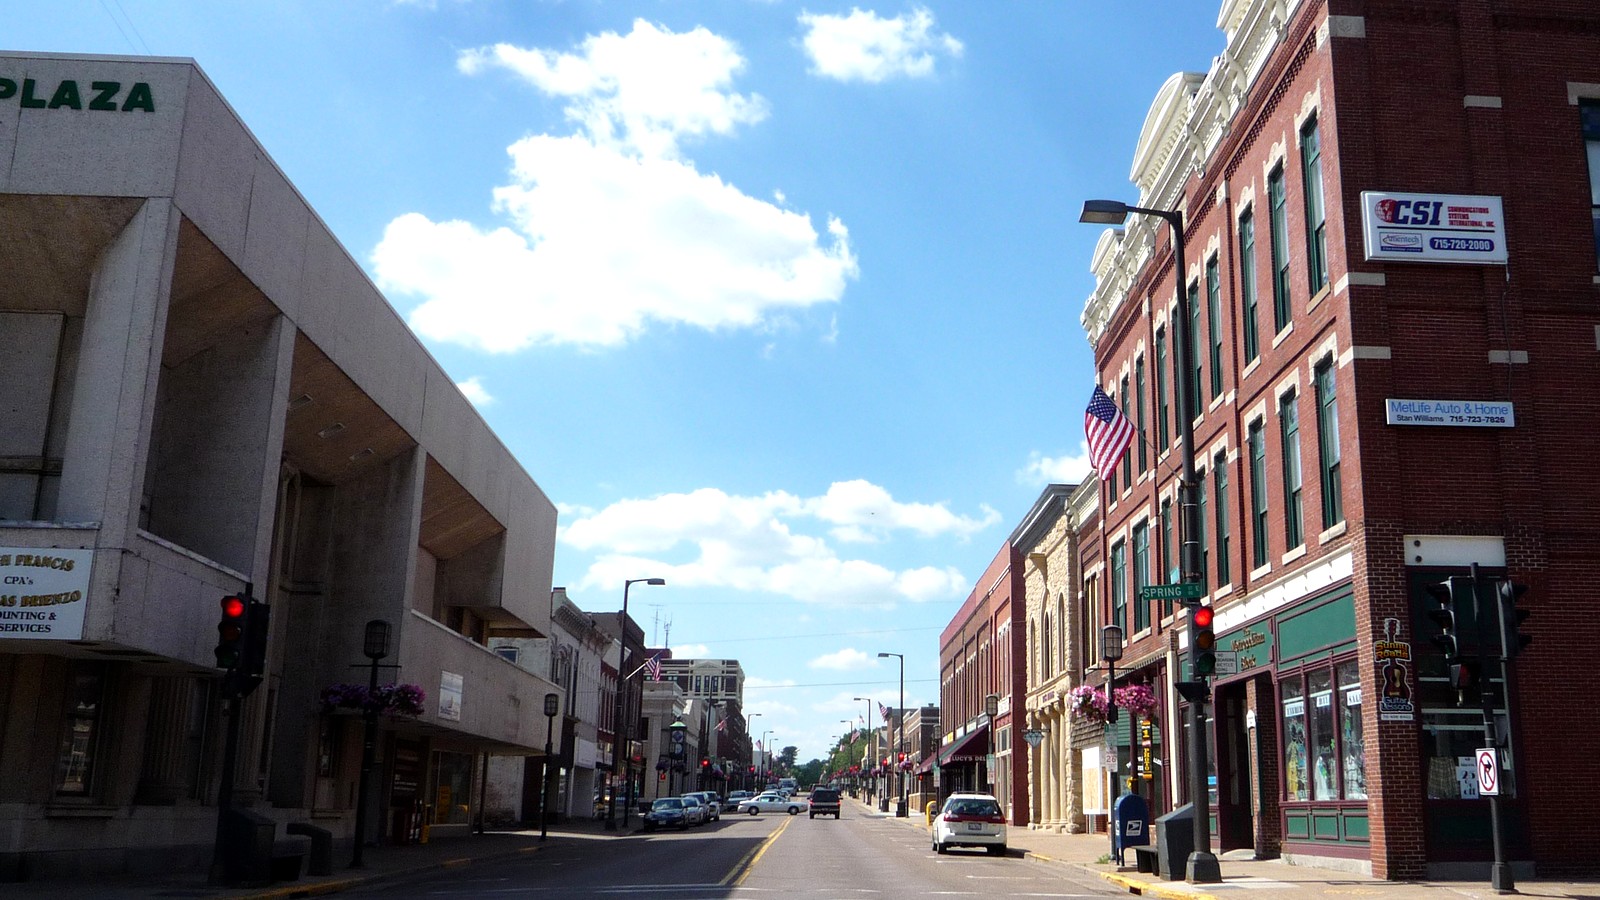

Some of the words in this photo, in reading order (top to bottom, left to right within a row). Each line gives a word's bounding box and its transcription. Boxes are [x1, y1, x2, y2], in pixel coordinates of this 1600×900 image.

[0, 78, 155, 112] PLAZA
[1392, 200, 1443, 226] CSI
[1434, 239, 1490, 250] 715-720-2000
[1391, 402, 1431, 413] MetLife
[1435, 403, 1461, 414] Auto
[1464, 403, 1472, 414] &
[1475, 403, 1508, 415] Home
[1396, 414, 1413, 422] Stan
[15, 554, 75, 572] FRANCIS
[4, 576, 34, 586] CPA's
[1144, 587, 1182, 598] SPRING
[0, 611, 46, 621] UNTING
[48, 612, 57, 621] &
[0, 623, 52, 633] SERVICES
[1375, 642, 1407, 653] Sunny
[1106, 755, 1117, 763] 26
